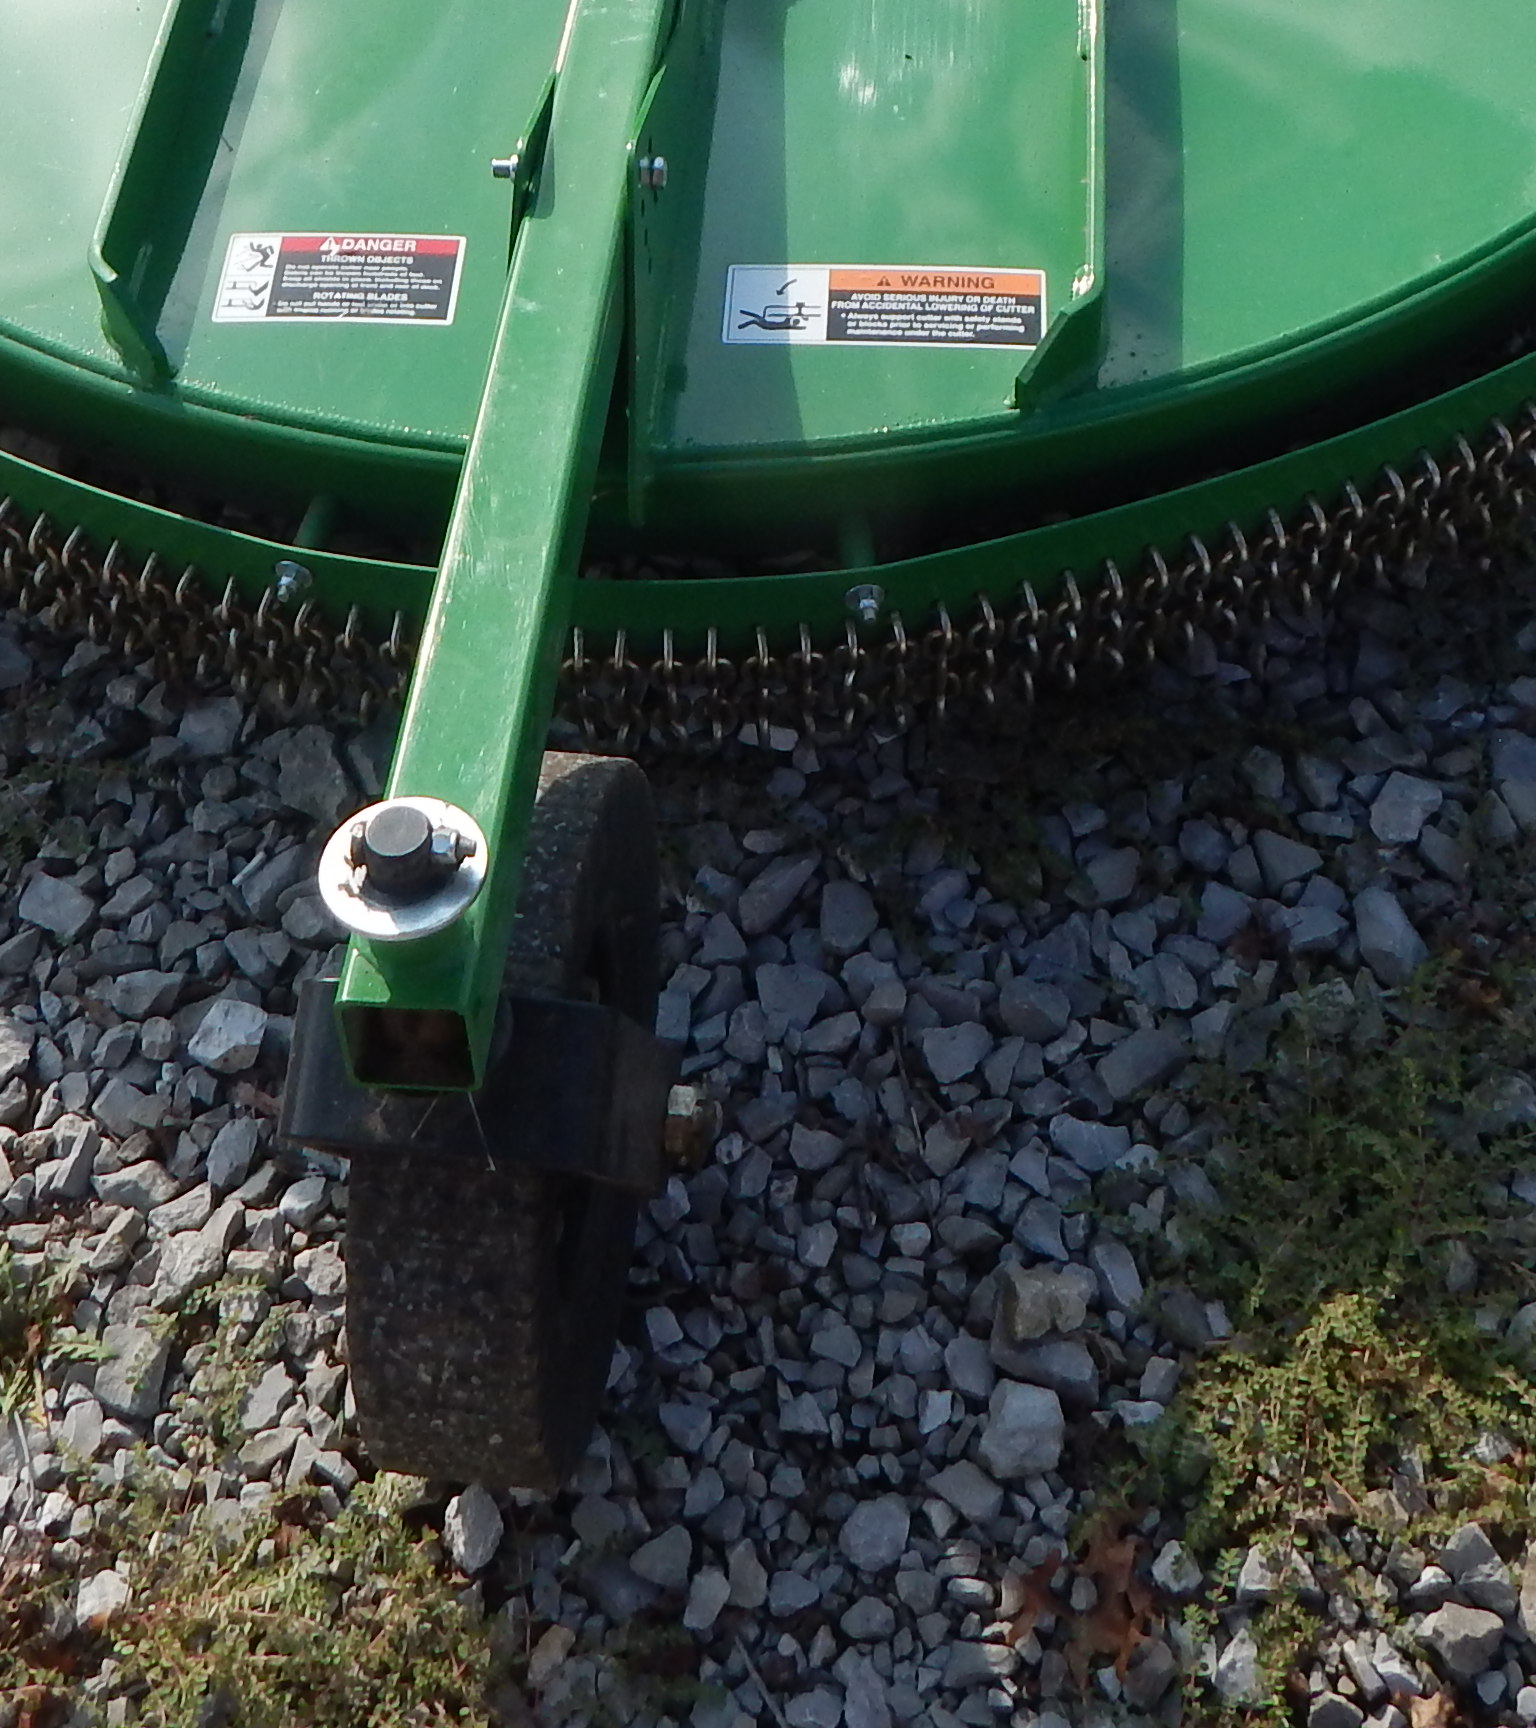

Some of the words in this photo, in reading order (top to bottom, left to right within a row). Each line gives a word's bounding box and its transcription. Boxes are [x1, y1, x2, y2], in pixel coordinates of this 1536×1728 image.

[341, 238, 417, 252] DANGER
[321, 254, 365, 263] THROWN
[366, 256, 414, 265] OBJECTS
[901, 275, 995, 289] WARNING
[312, 292, 365, 301] ROTATING
[366, 293, 408, 302] BLADES
[851, 293, 882, 301] AVOID
[883, 293, 927, 302] SERIOUS
[928, 294, 964, 303] INJURY
[965, 295, 981, 304] OR
[982, 296, 1016, 305] DEATH
[831, 301, 861, 309] FROM
[861, 301, 924, 311] ACCIDENTAL
[925, 303, 978, 312] LOWERING
[980, 304, 994, 312] OF
[995, 305, 1035, 314] CUTTER
